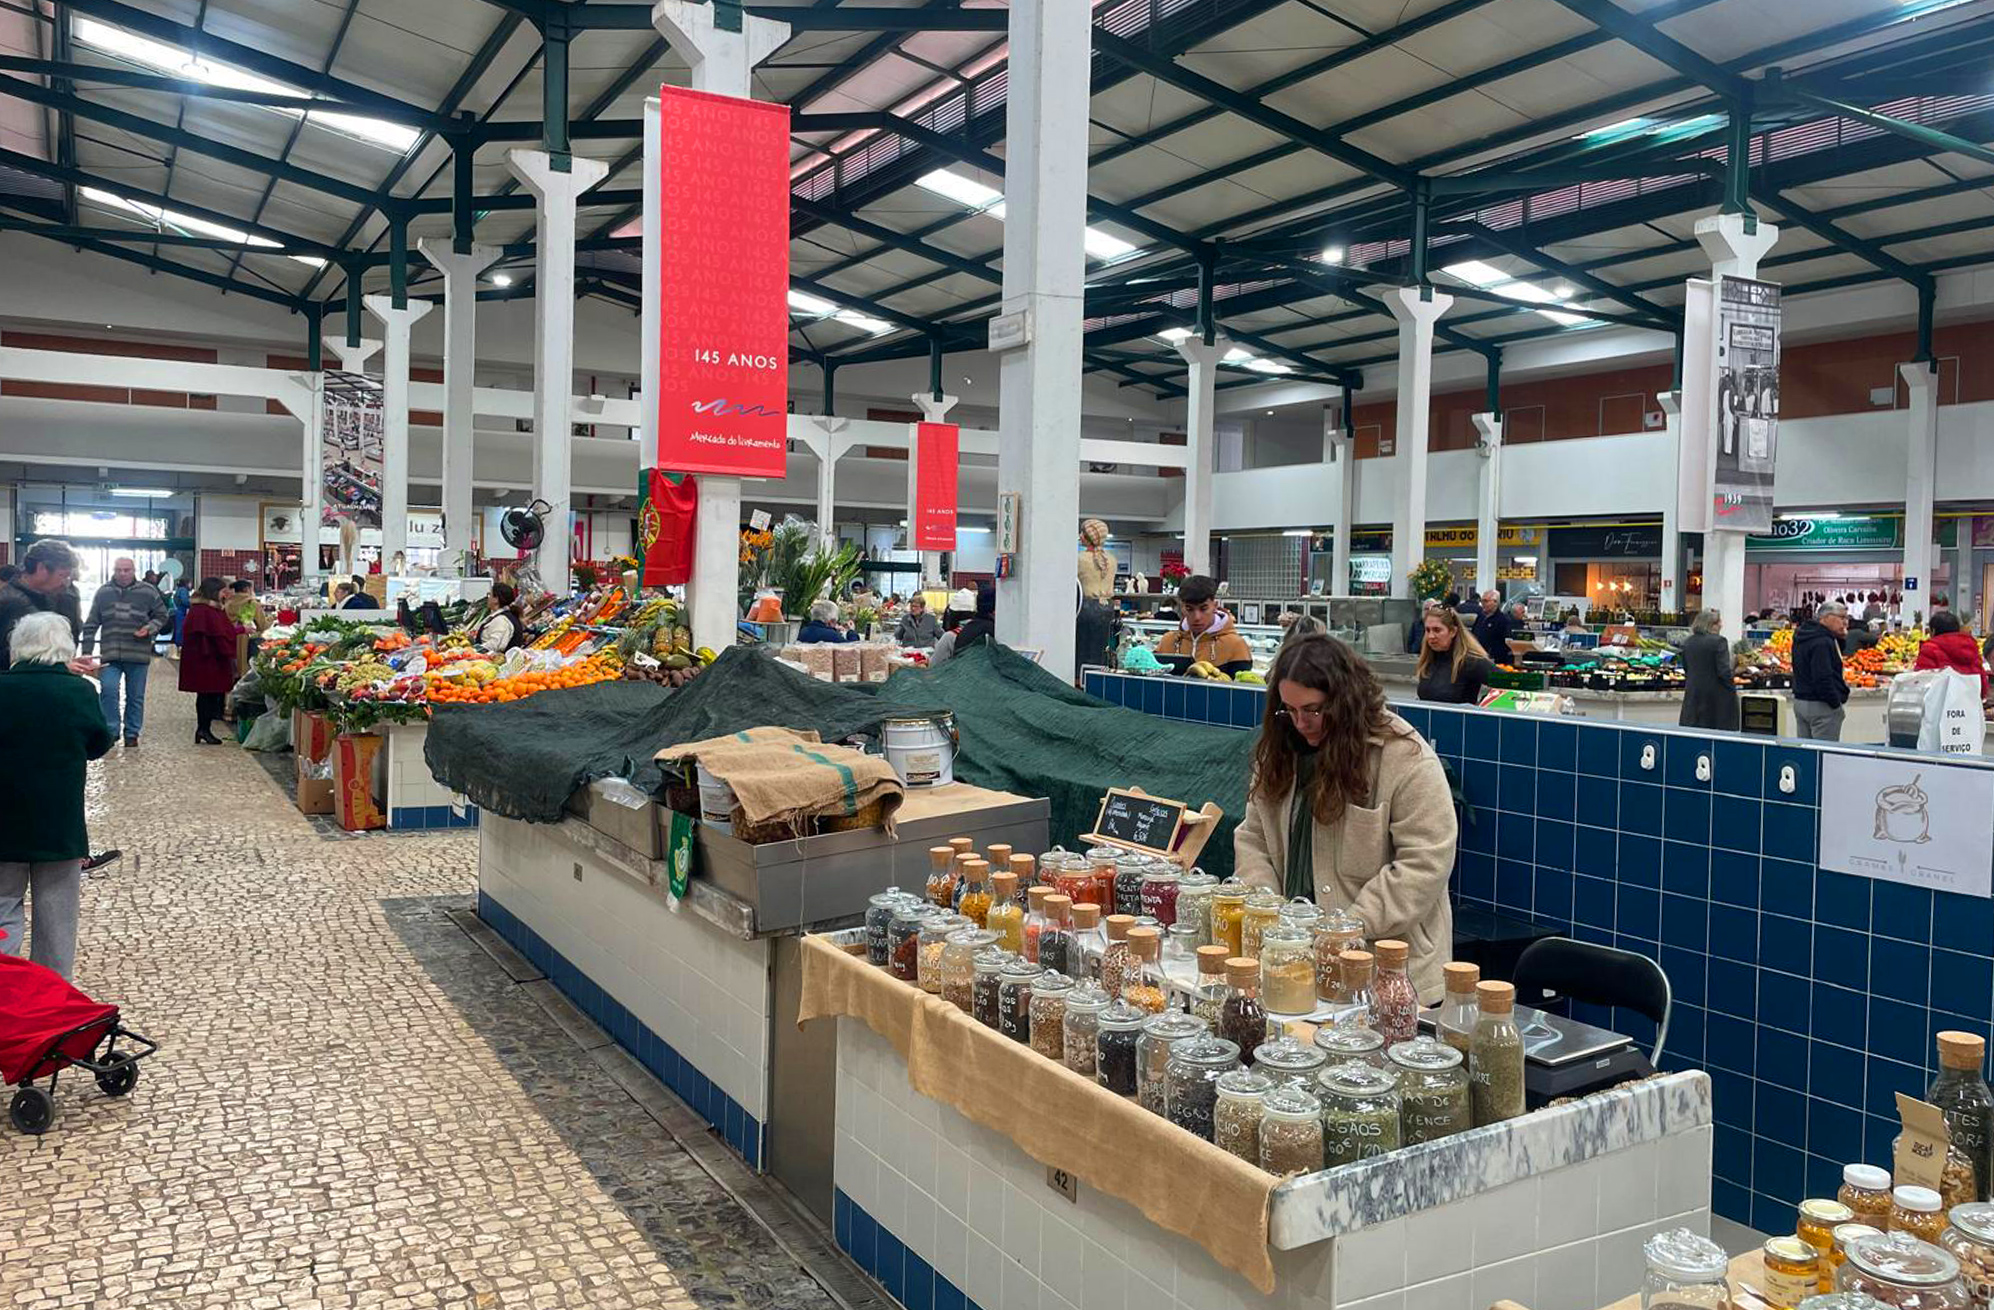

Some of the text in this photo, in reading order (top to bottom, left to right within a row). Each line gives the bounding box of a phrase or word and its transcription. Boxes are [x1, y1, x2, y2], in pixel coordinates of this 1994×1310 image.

[695, 348, 777, 370] 145 ANOS
[1946, 709, 1966, 719] FORA
[1951, 727, 1961, 736] DE
[1054, 1168, 1068, 1191] 42
